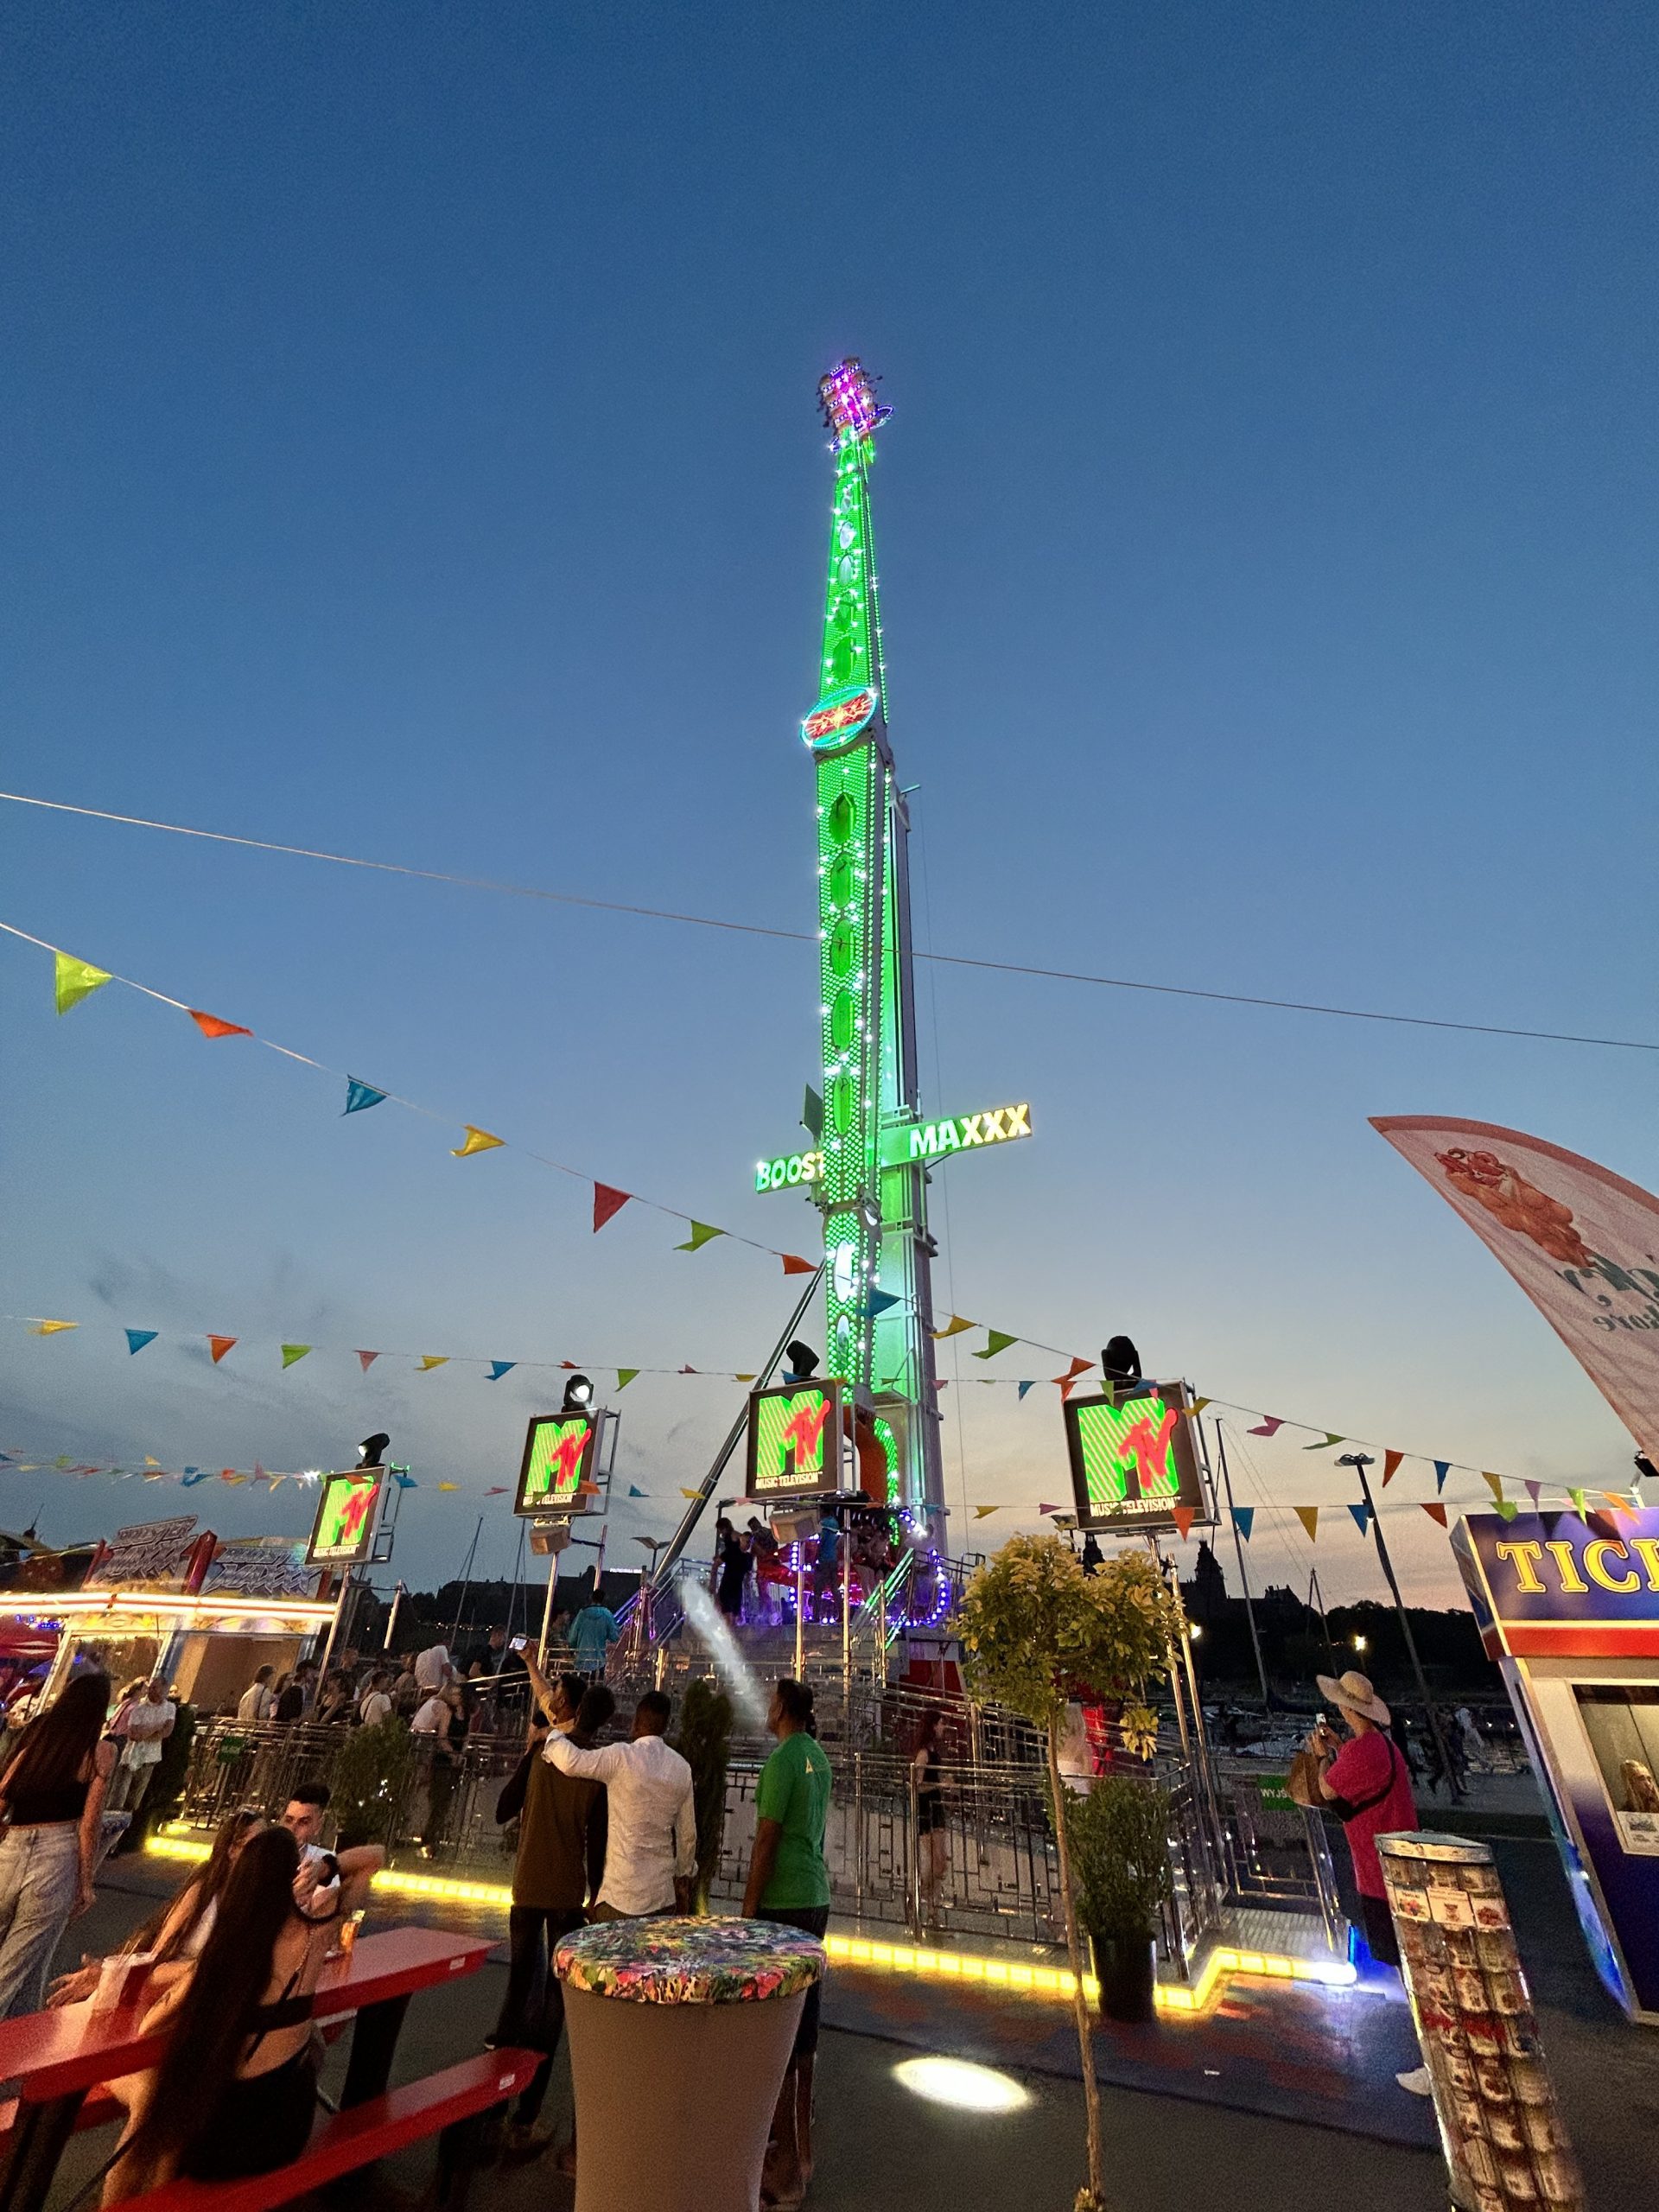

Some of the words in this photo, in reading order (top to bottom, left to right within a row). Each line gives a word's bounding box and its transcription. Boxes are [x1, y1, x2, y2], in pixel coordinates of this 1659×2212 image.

[909, 1103, 1032, 1159] MAXXX
[524, 1419, 592, 1496] MTV
[757, 1389, 831, 1478] MTV
[1077, 1397, 1179, 1503] MTV
[316, 1476, 380, 1547] MTV
[755, 1478, 778, 1489] MUSIC
[779, 1472, 819, 1487] TELEVISION
[1261, 1788, 1292, 1799] WYJŚ
